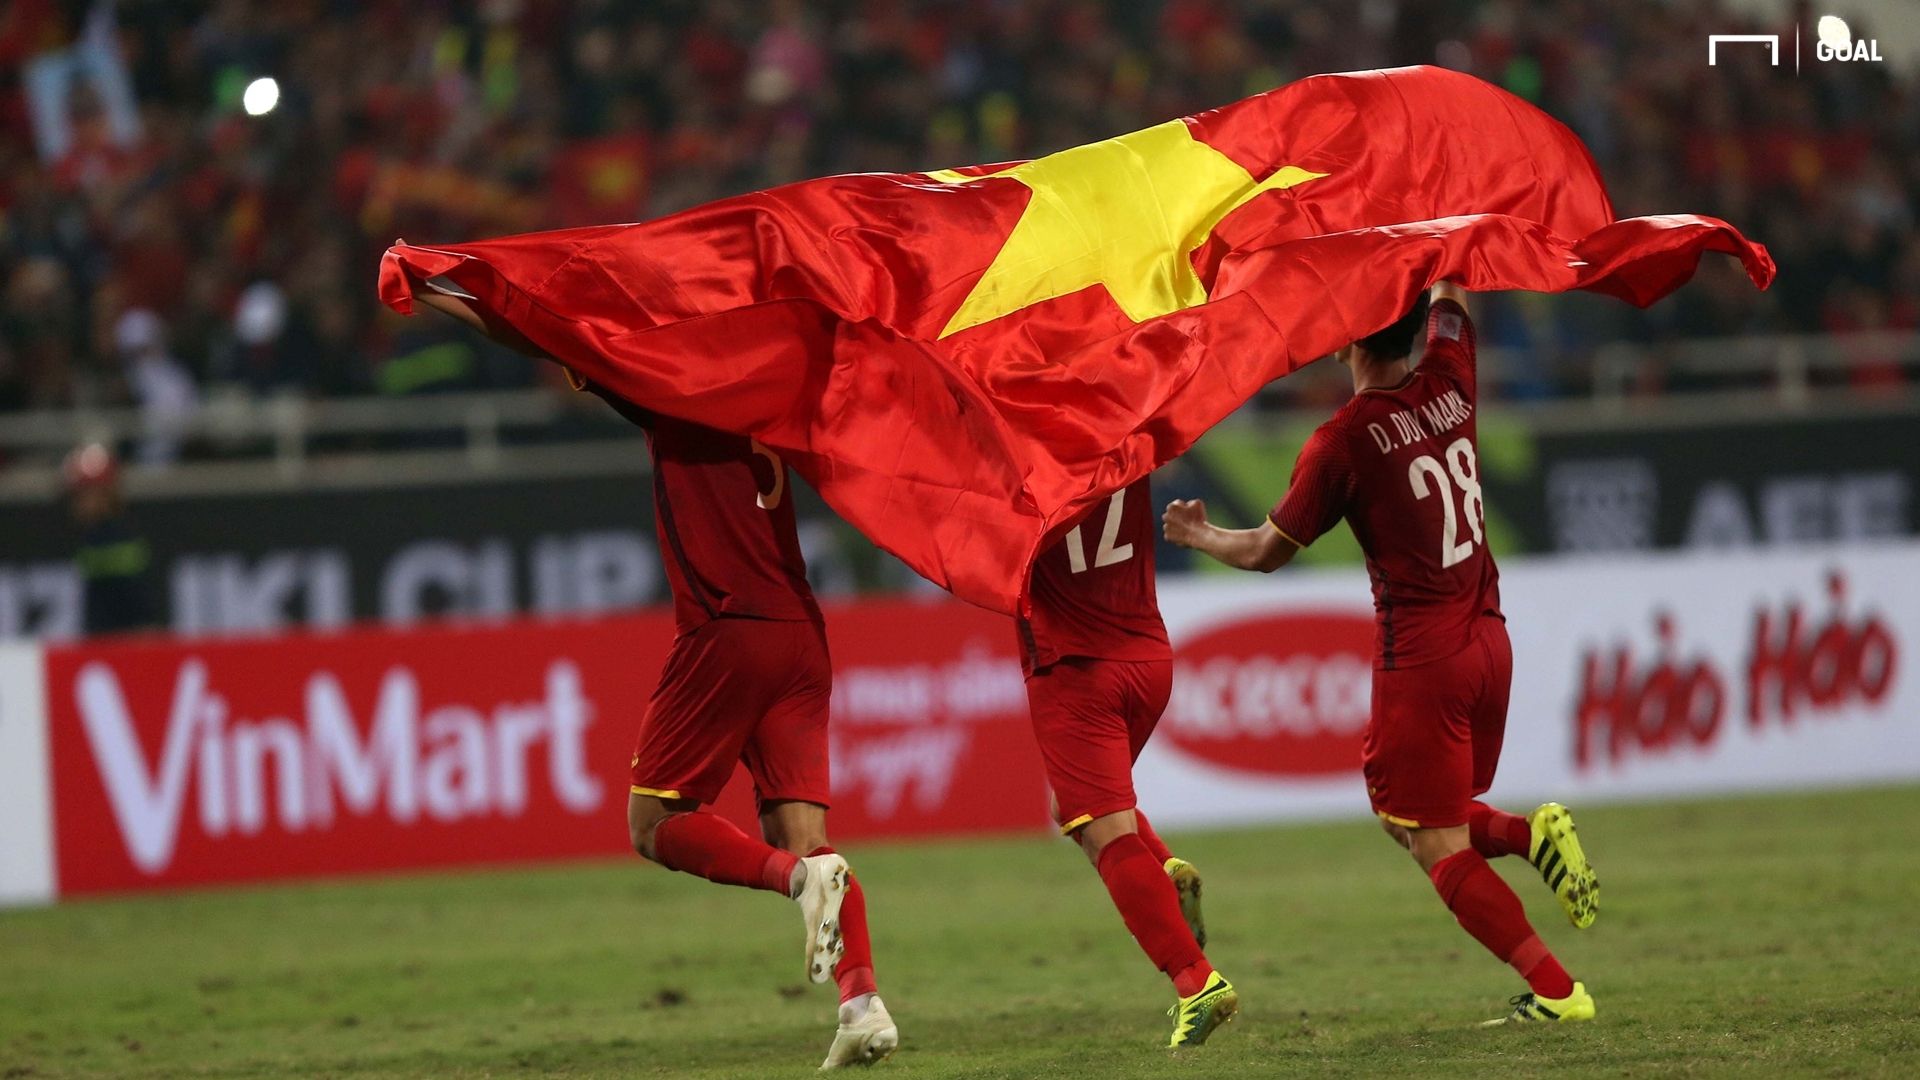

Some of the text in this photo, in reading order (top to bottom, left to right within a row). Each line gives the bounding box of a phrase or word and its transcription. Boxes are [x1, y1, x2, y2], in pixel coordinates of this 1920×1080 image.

[1367, 422, 1399, 455] D.
[1408, 437, 1484, 569] 28
[73, 658, 604, 874] VinMart
